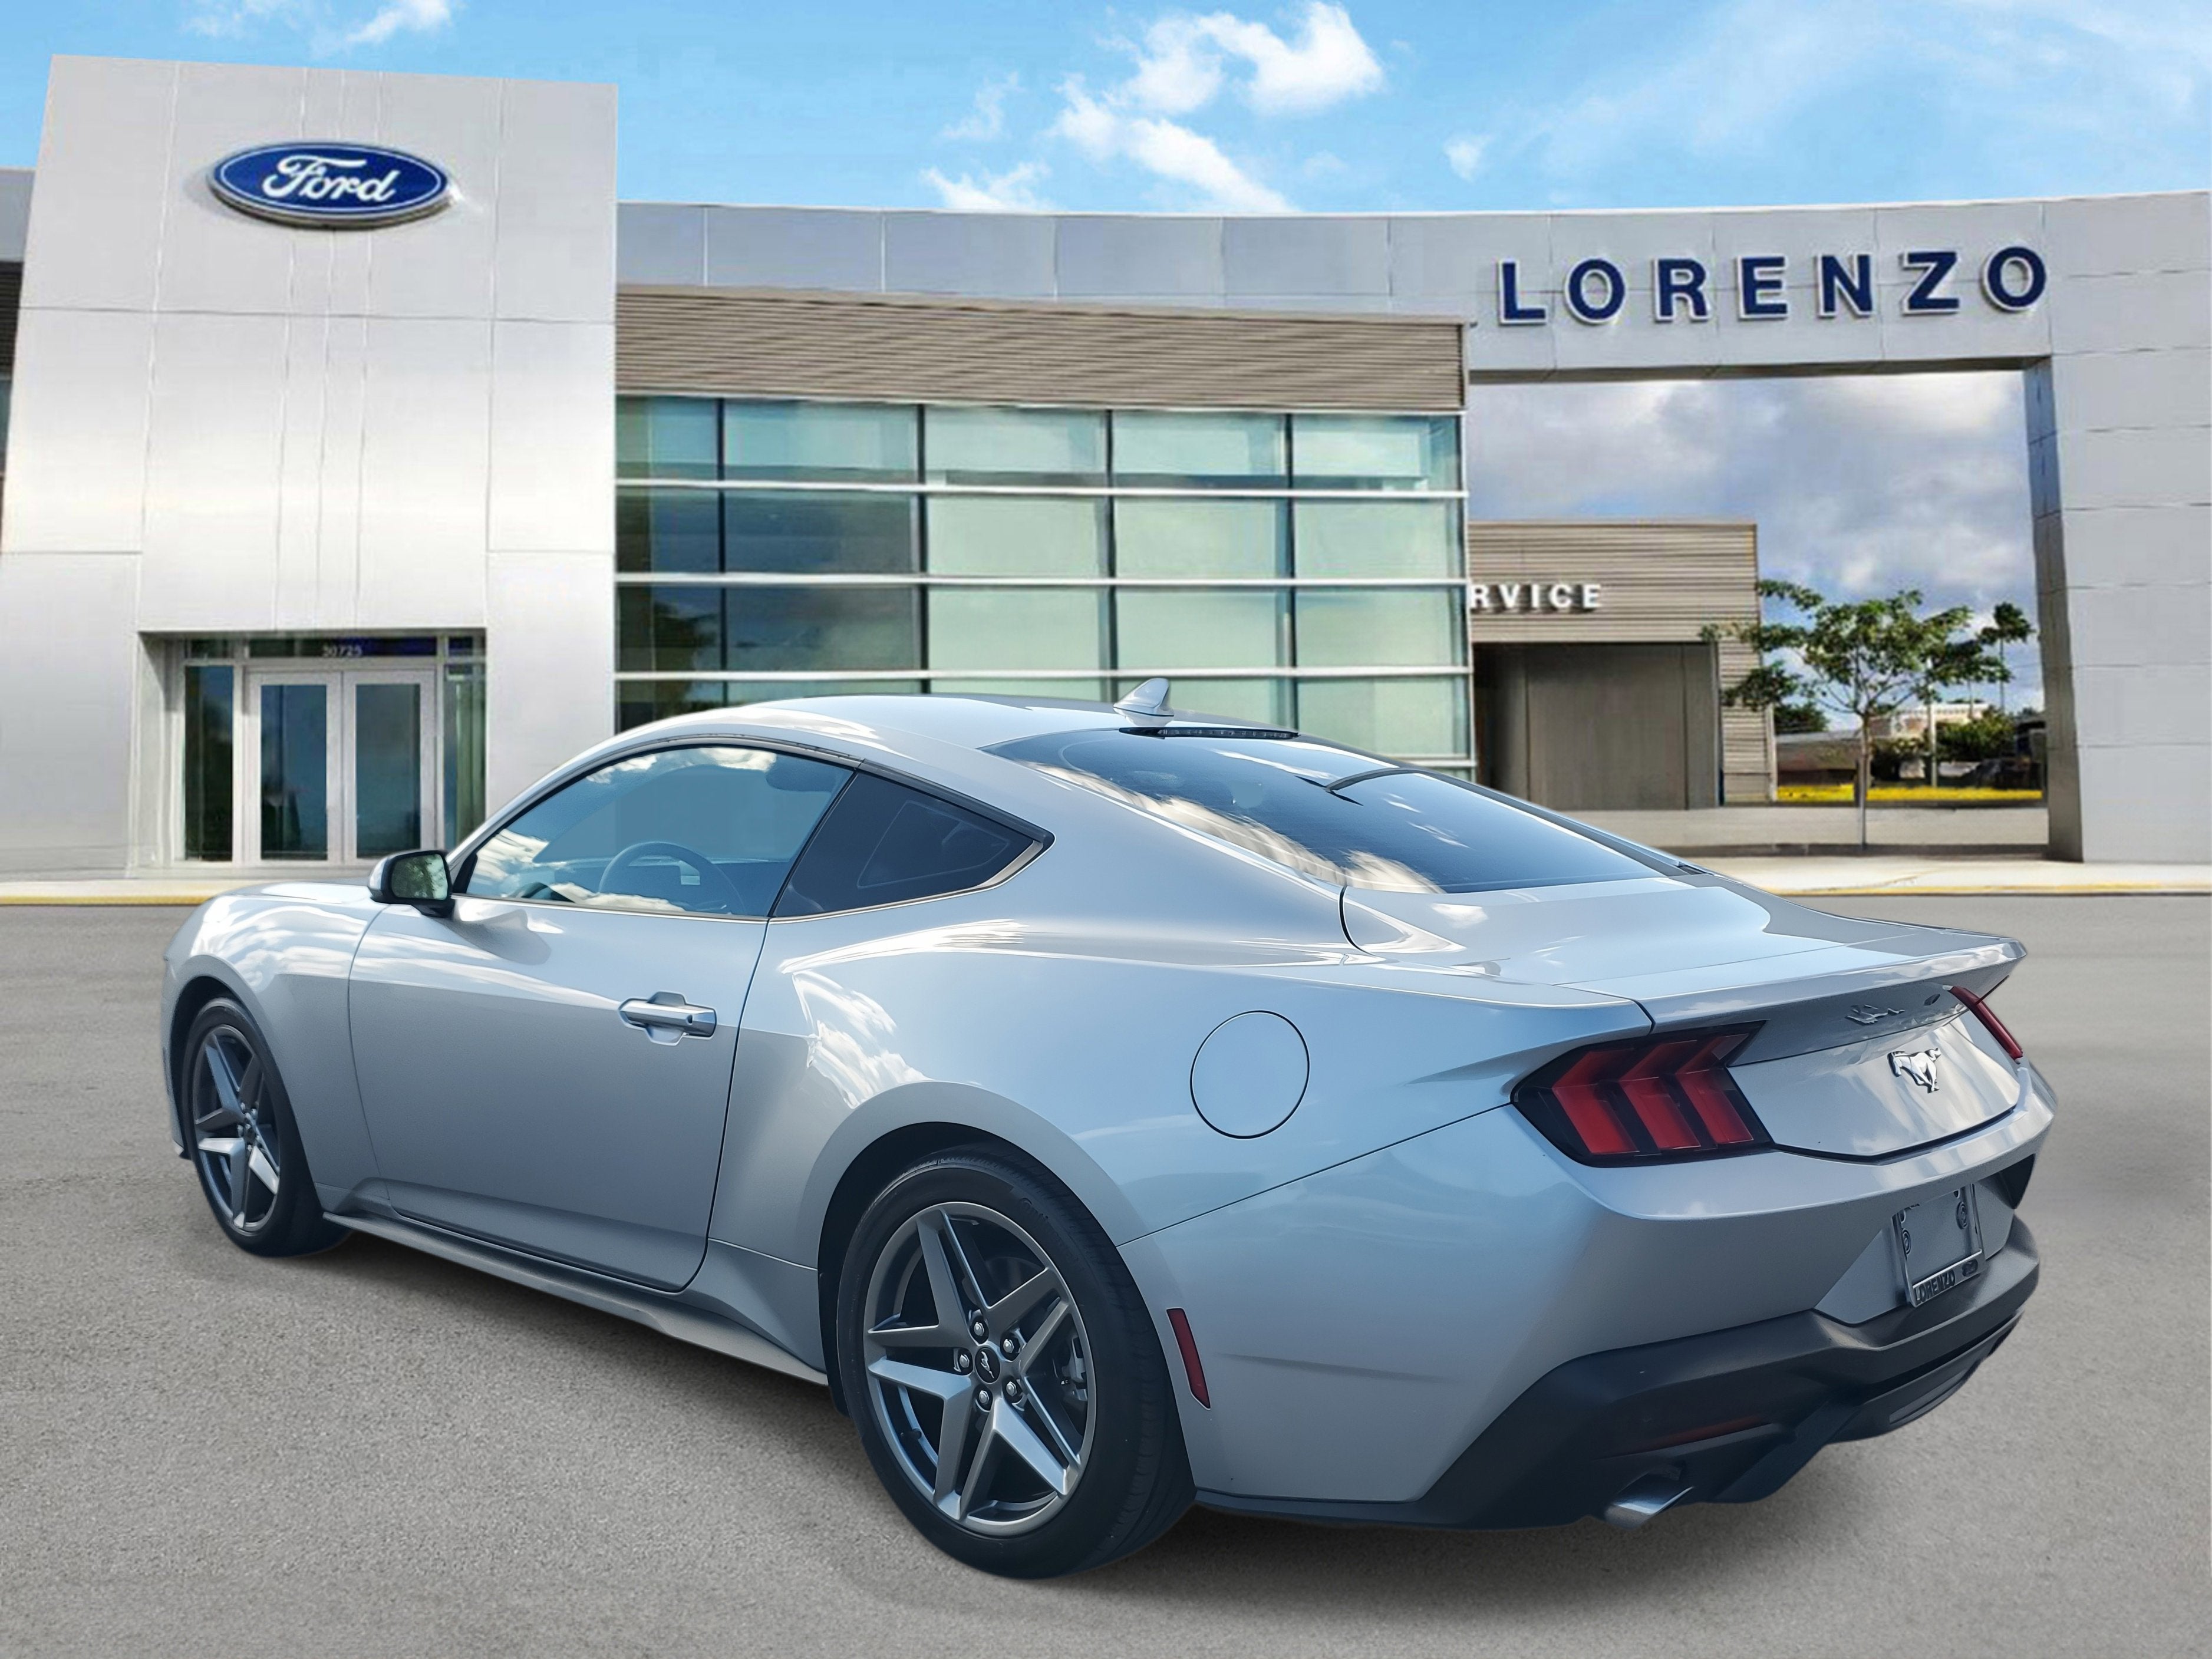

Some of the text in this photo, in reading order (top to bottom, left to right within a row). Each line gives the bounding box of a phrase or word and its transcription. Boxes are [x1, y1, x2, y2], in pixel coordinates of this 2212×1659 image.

[262, 154, 401, 202] Ford
[1498, 246, 2048, 325] LORENZO
[1471, 584, 1601, 608] RVICE
[1915, 1269, 1956, 1304] LORENZO
